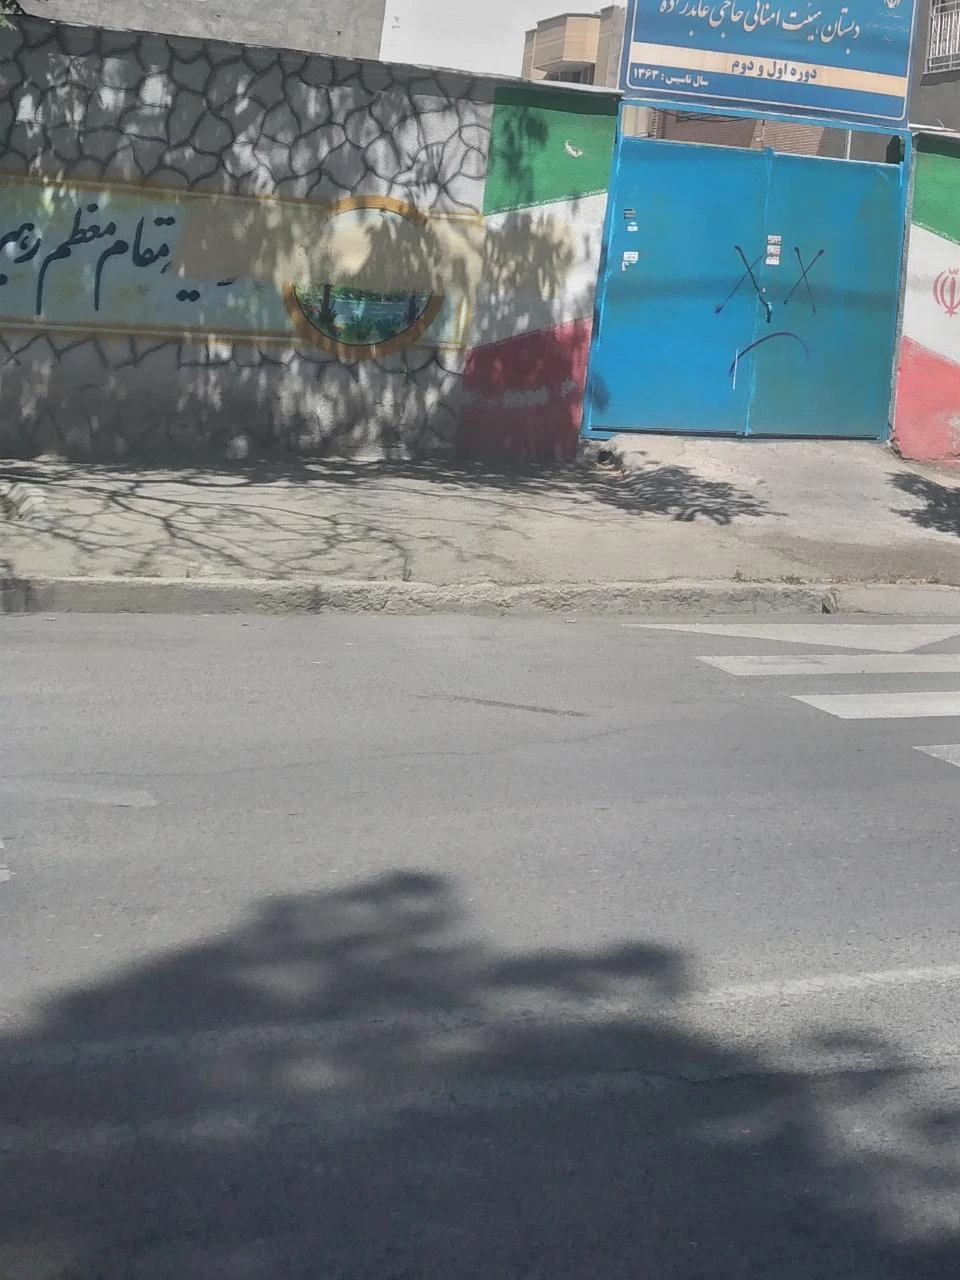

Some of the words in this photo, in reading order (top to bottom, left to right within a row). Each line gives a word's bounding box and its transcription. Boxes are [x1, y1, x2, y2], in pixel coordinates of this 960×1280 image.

[708, 0, 745, 40] حاجی
[820, 7, 861, 56] دبستان
[732, 60, 754, 74] دوم
[757, 64, 764, 77] و
[767, 60, 788, 79] اول
[790, 68, 817, 82] دوره
[692, 74, 709, 88] سال
[36, 203, 117, 315] معظم
[94, 216, 175, 312] مقام
